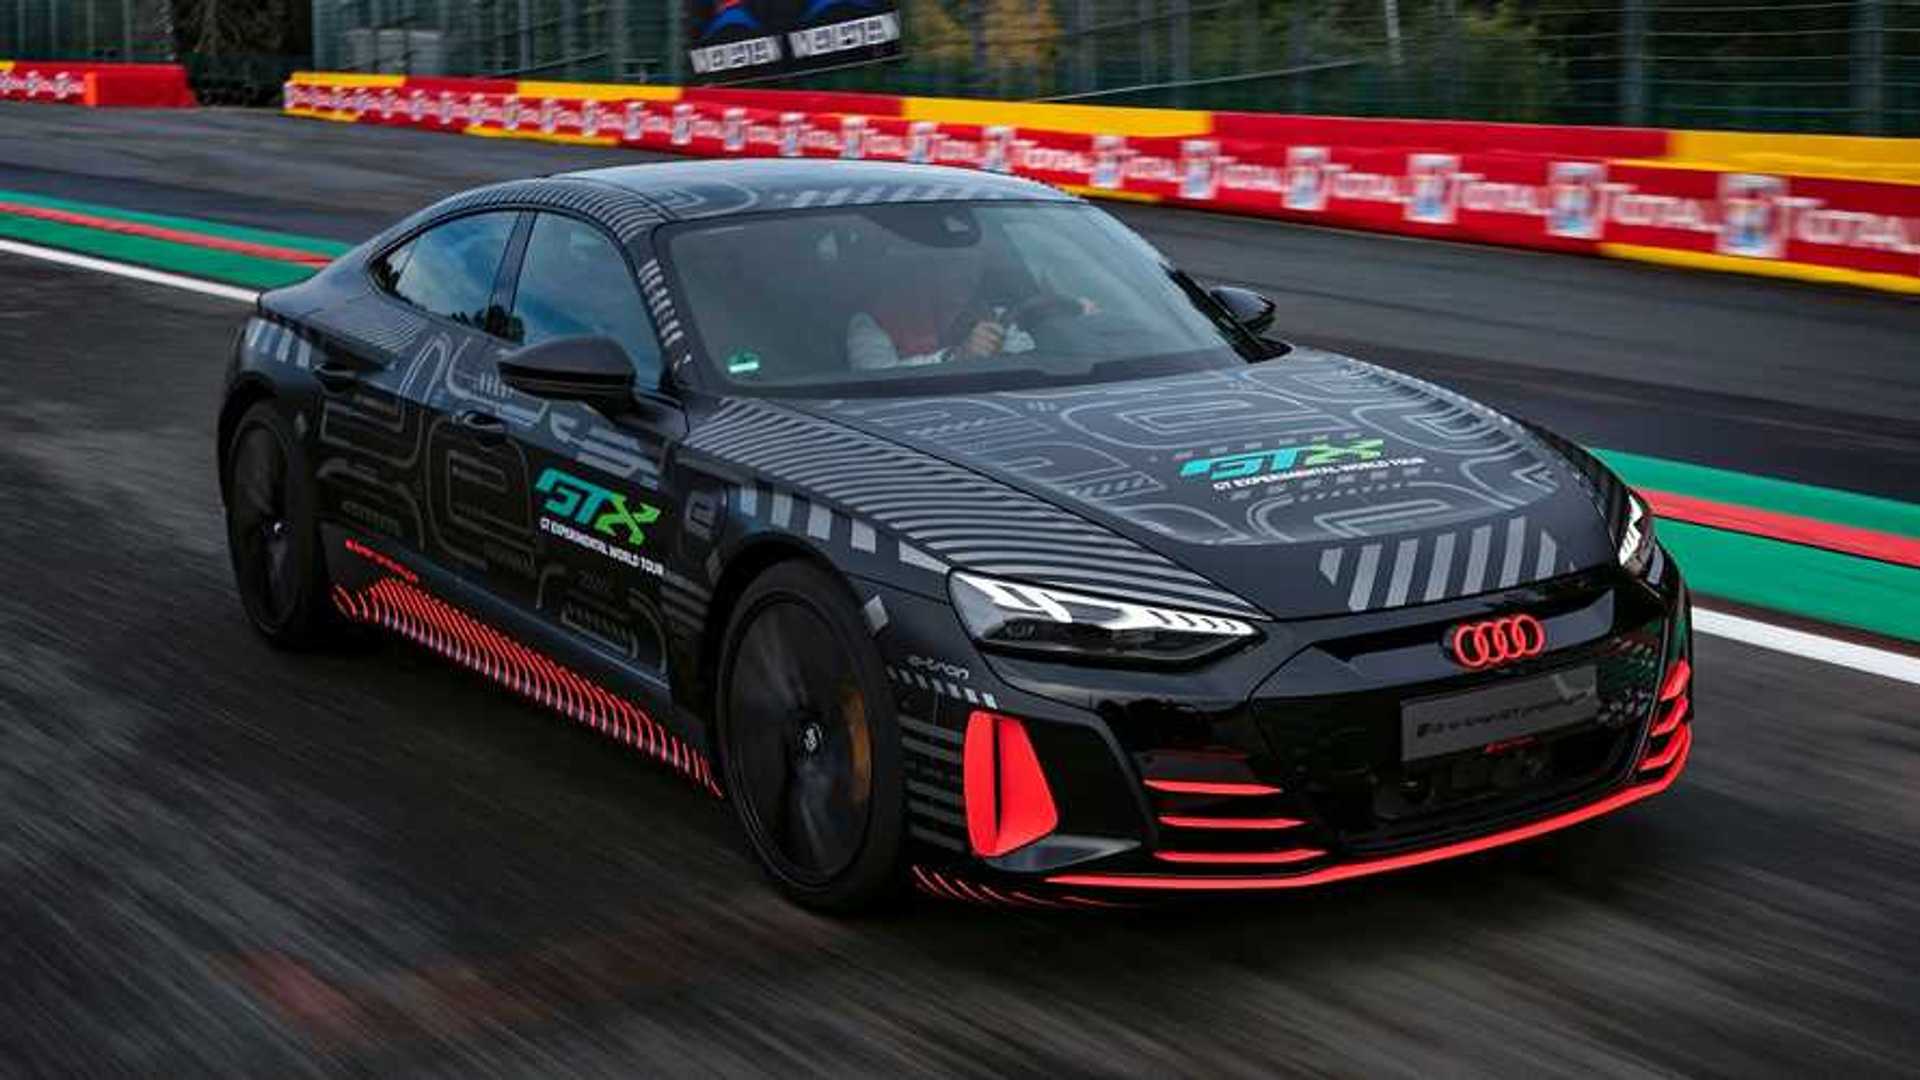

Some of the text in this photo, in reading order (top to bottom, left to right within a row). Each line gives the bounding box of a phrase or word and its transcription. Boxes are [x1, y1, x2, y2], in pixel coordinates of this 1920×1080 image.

[1006, 139, 1096, 174] TOTAL
[1447, 172, 1551, 217] TOTAL
[1590, 182, 1725, 234] TOTAL
[1768, 195, 1920, 254] TOTAL
